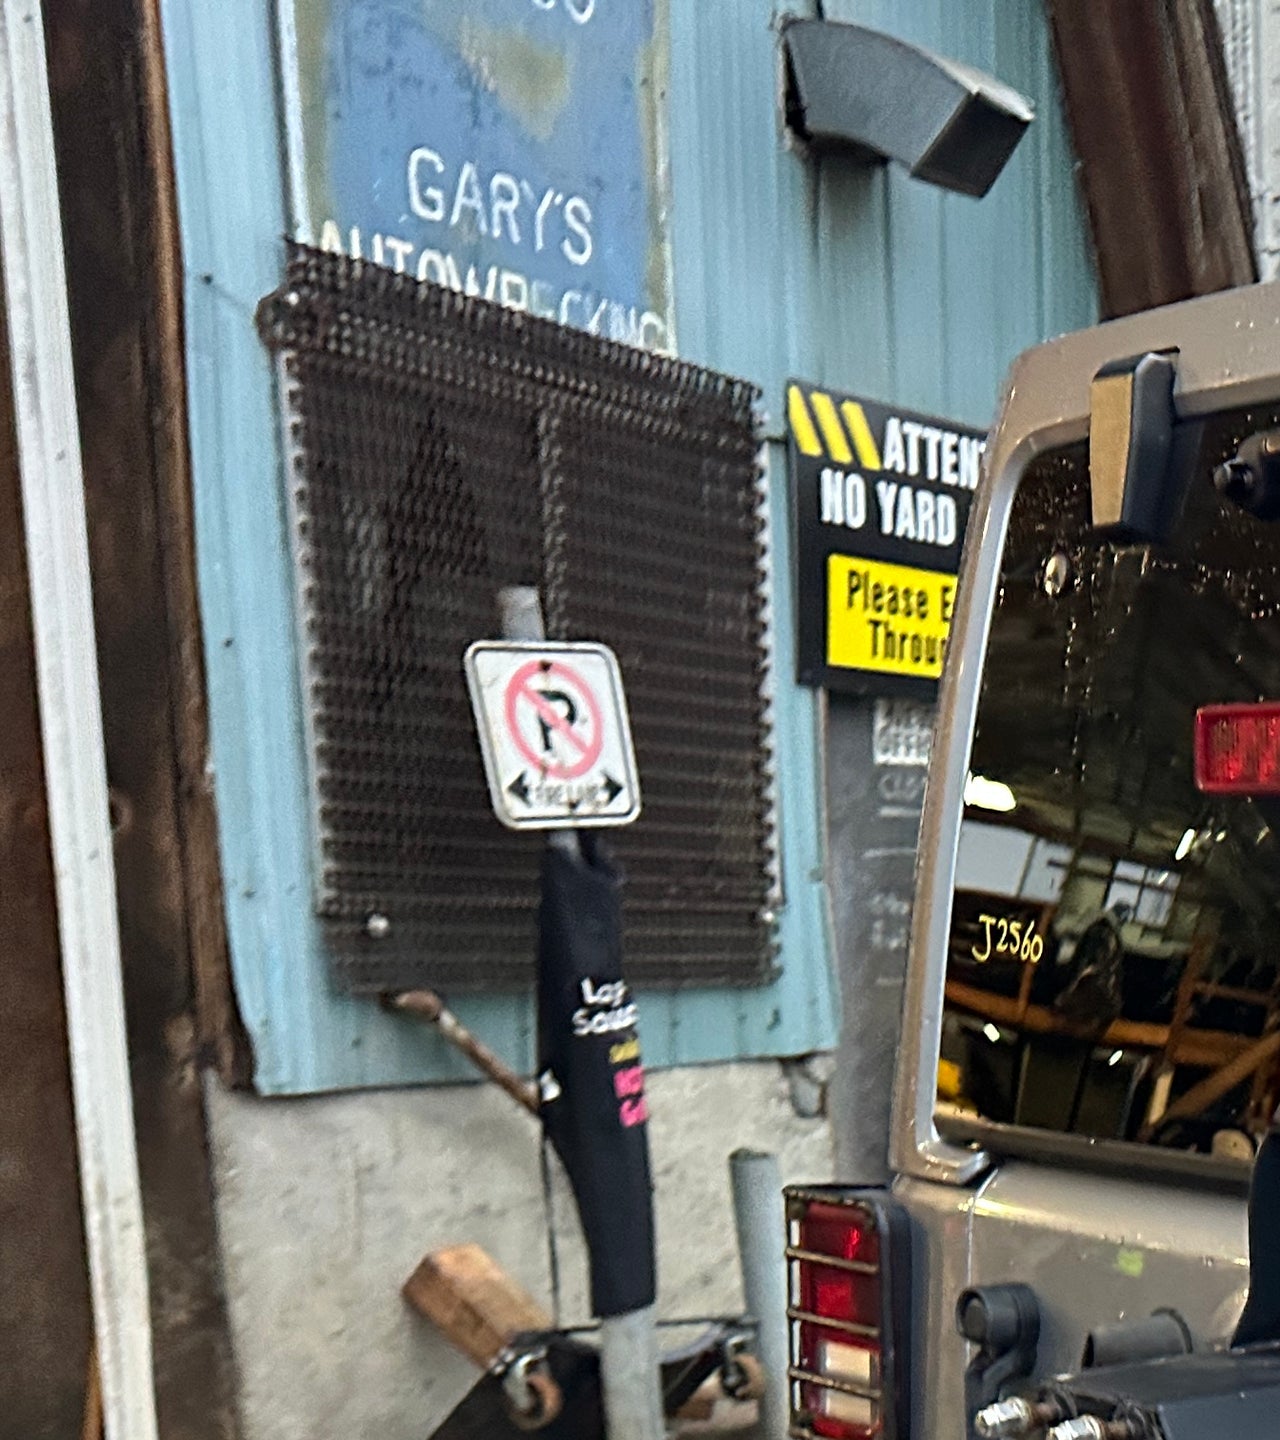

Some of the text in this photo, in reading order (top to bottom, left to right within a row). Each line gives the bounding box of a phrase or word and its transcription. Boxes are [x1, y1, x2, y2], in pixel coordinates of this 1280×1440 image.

[407, 146, 593, 266] GARY'S
[883, 417, 986, 490] ATTEN
[819, 467, 956, 546] NO YARD
[847, 571, 929, 620] Please
[868, 620, 948, 665] Throu
[971, 914, 1044, 963] J2560
